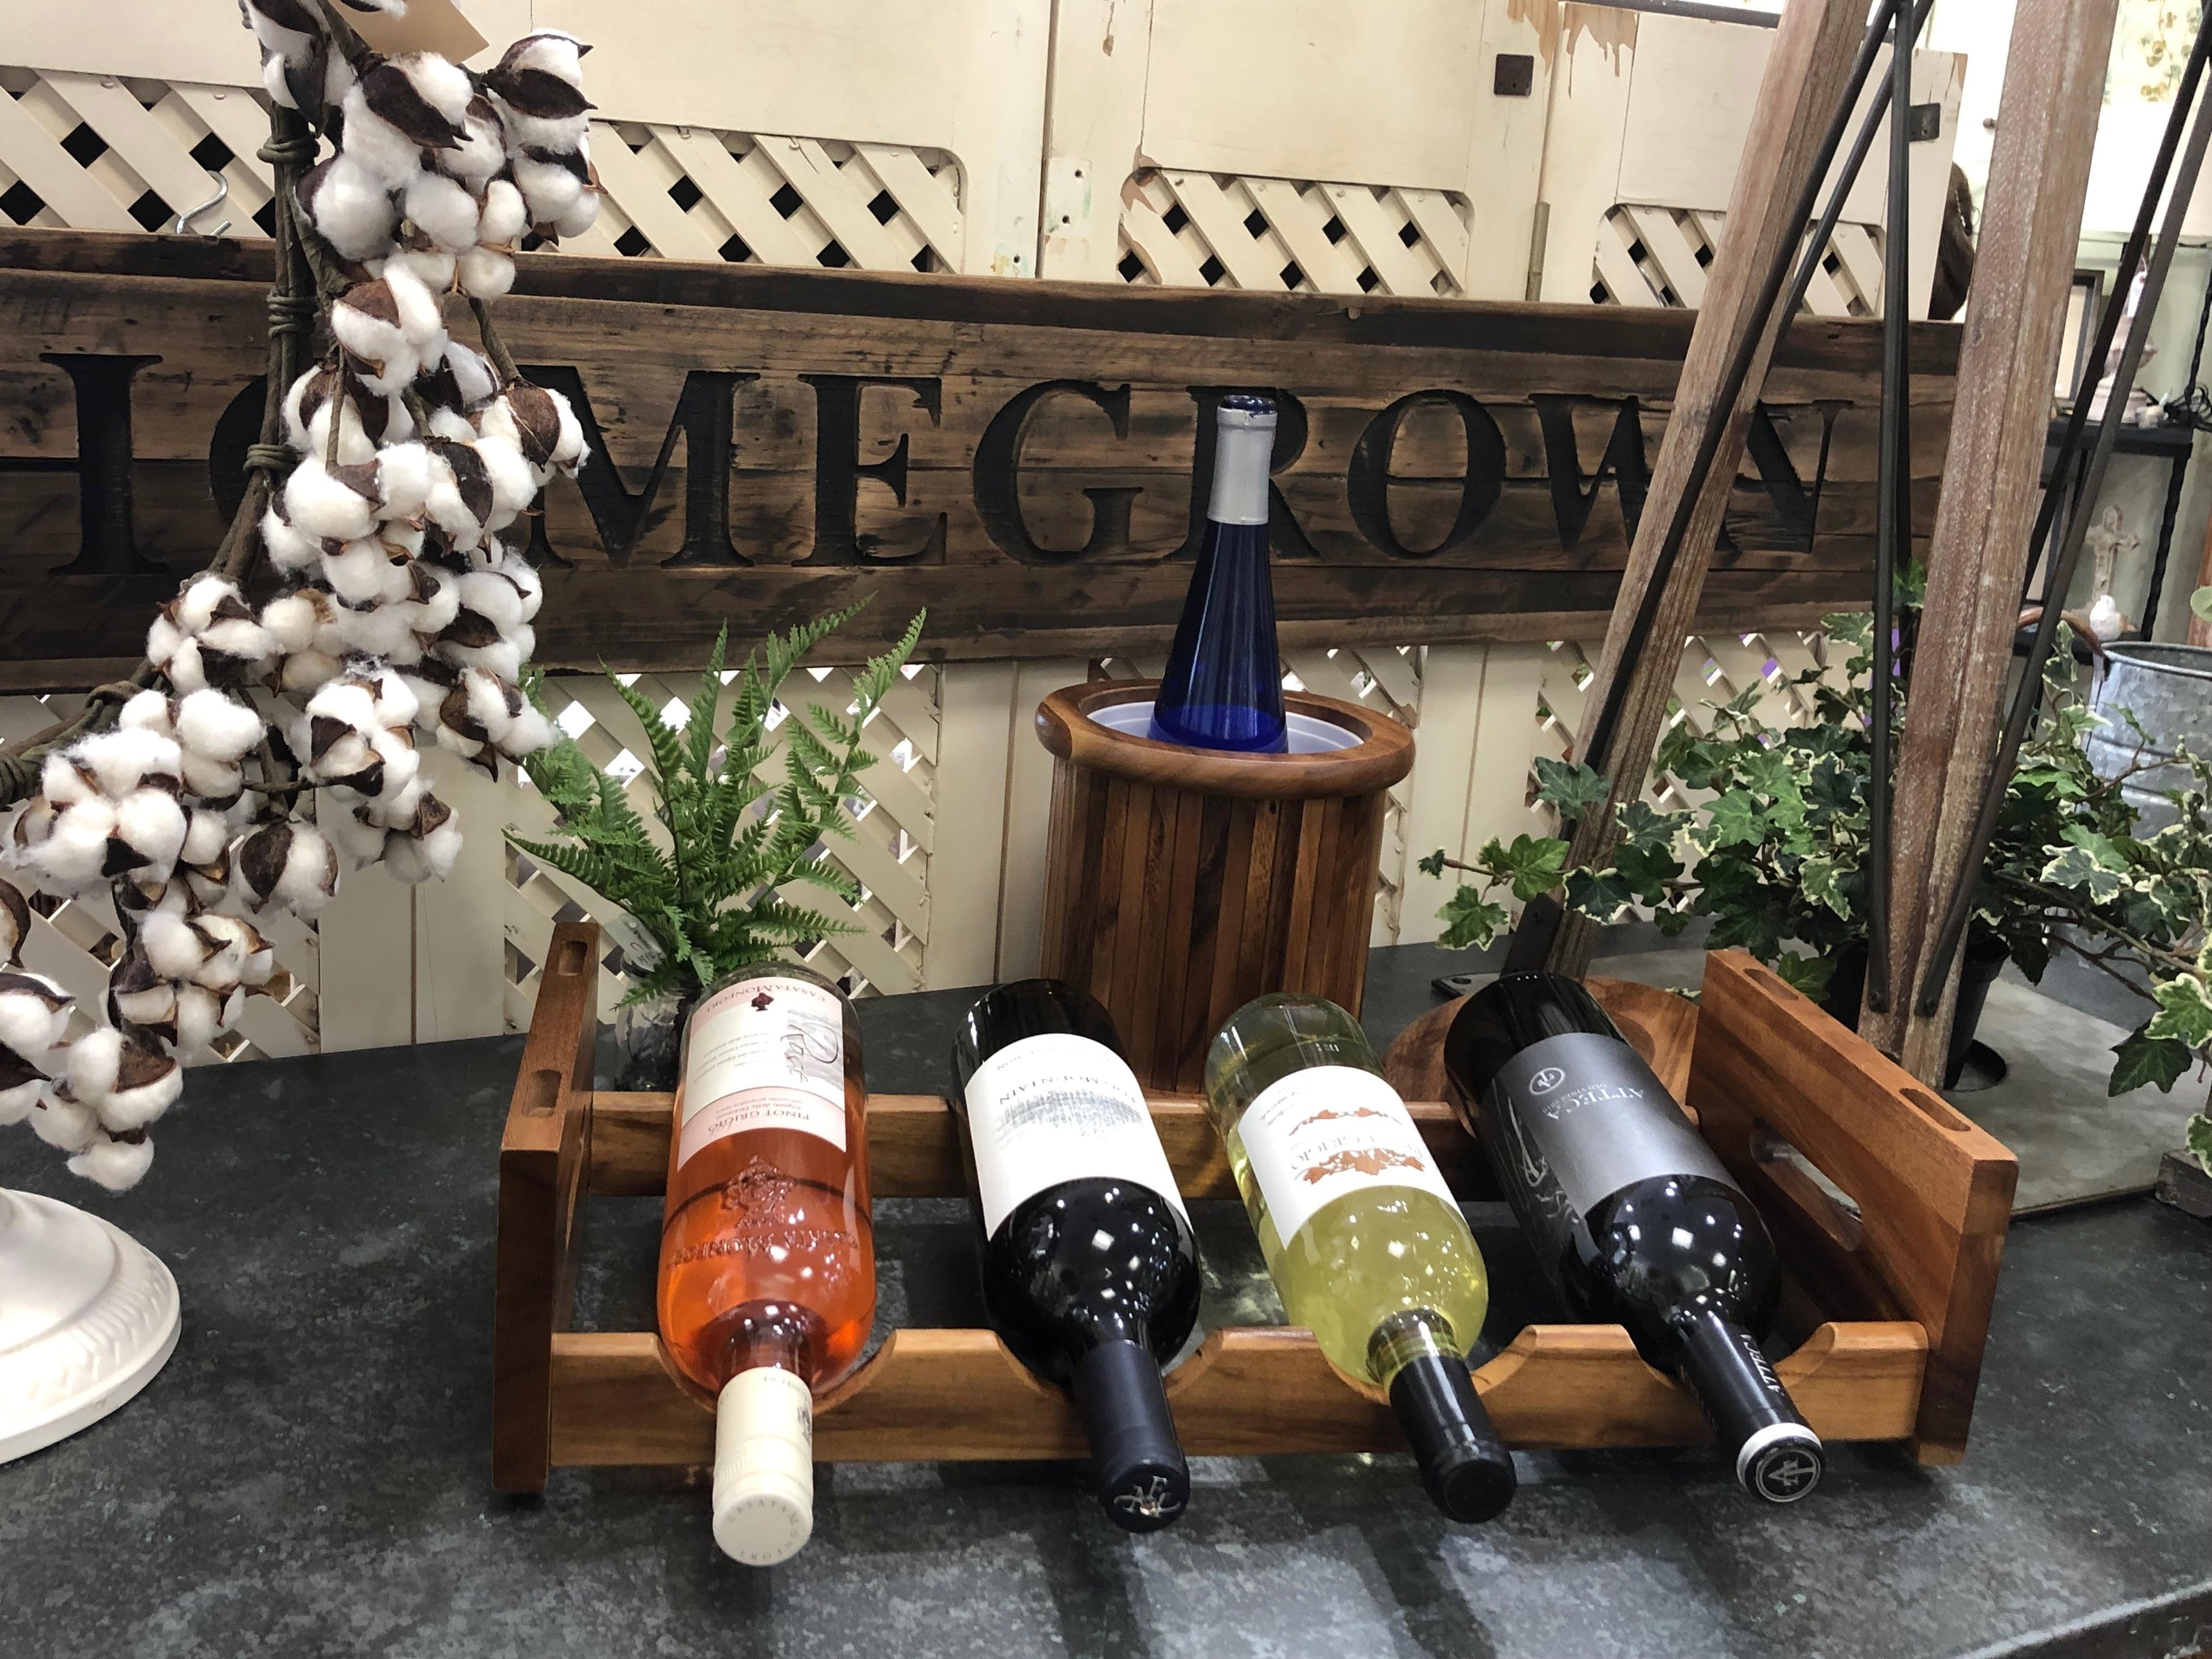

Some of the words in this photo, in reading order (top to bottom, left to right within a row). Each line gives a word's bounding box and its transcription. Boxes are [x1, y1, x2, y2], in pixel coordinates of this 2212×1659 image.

[0, 353, 1853, 575] HMEGROWN
[764, 1108, 810, 1120] PINOT
[1546, 1086, 1644, 1120] ATTECA
